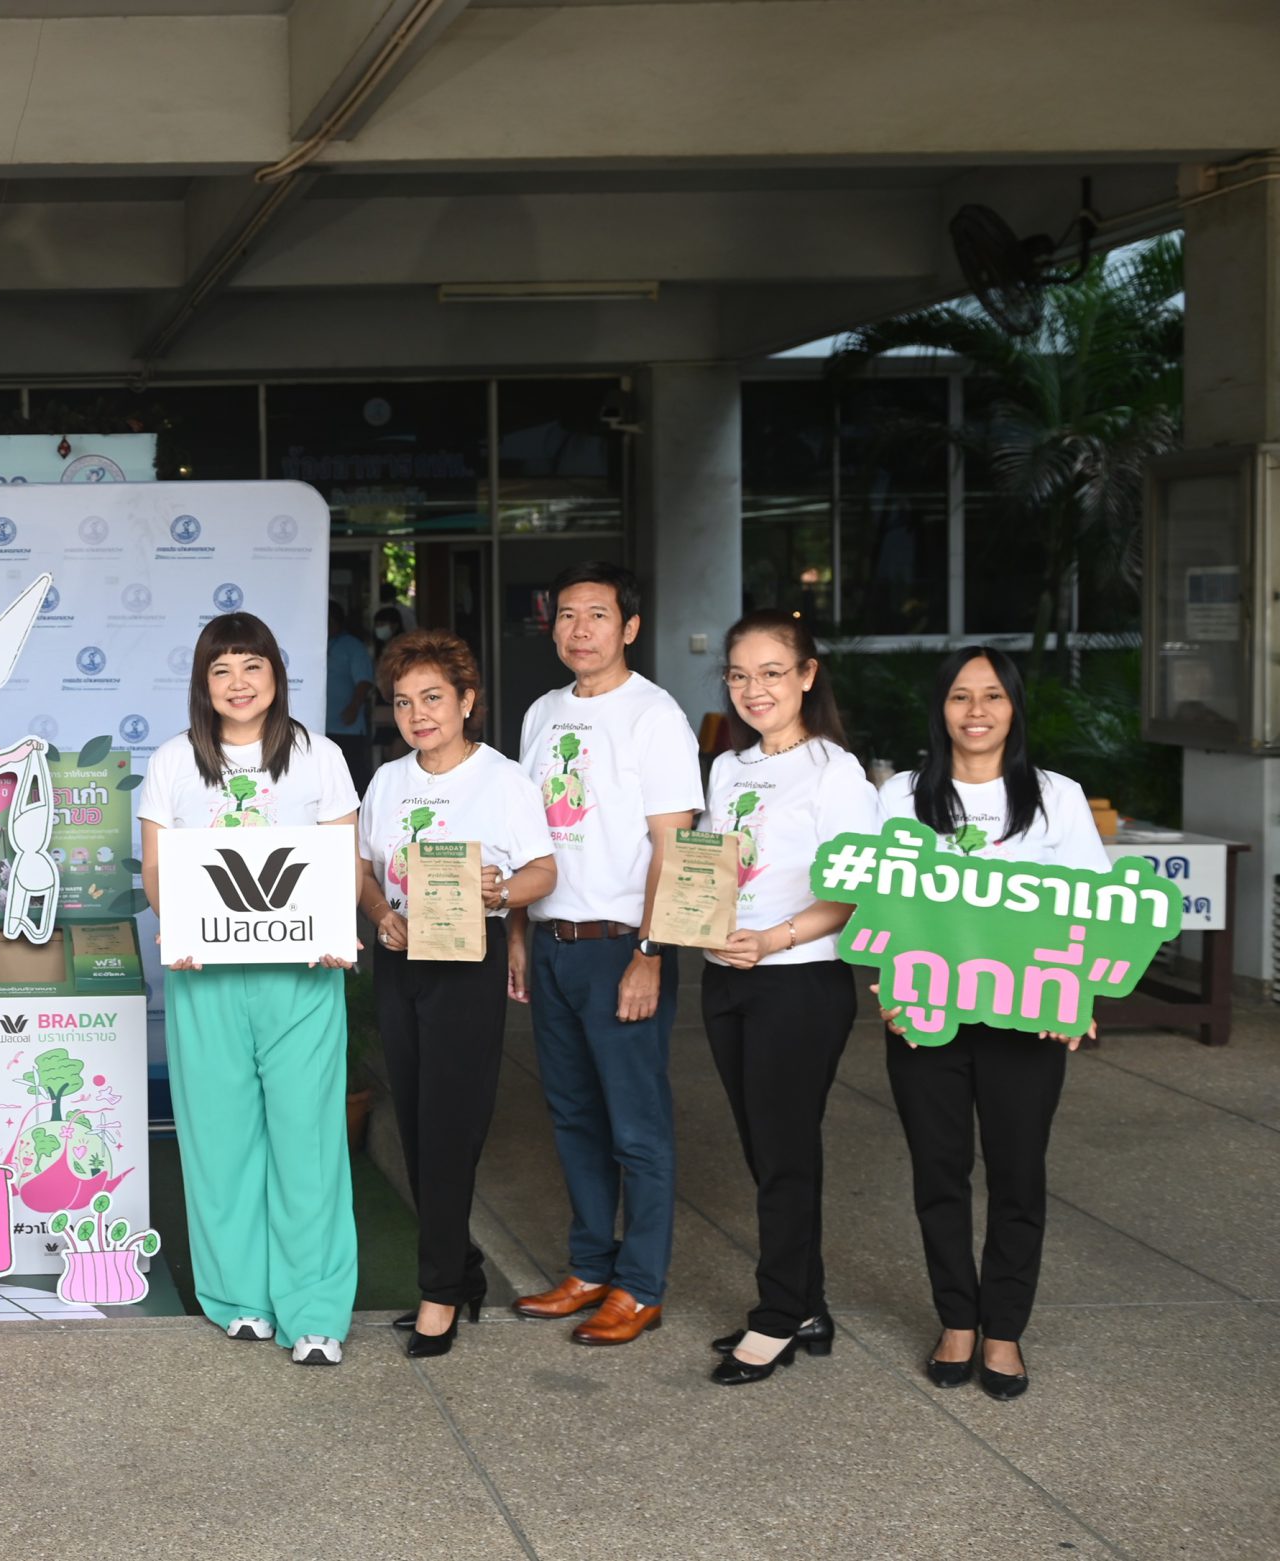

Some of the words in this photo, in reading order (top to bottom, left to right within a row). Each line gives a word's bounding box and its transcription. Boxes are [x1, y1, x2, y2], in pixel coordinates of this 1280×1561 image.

[822, 829, 1169, 929] #ทิ้งบราเก่า
[201, 915, 314, 943] Wacoal
[37, 1012, 118, 1029] BRADAY
[37, 1029, 117, 1043] บราเก่าเราขอ
